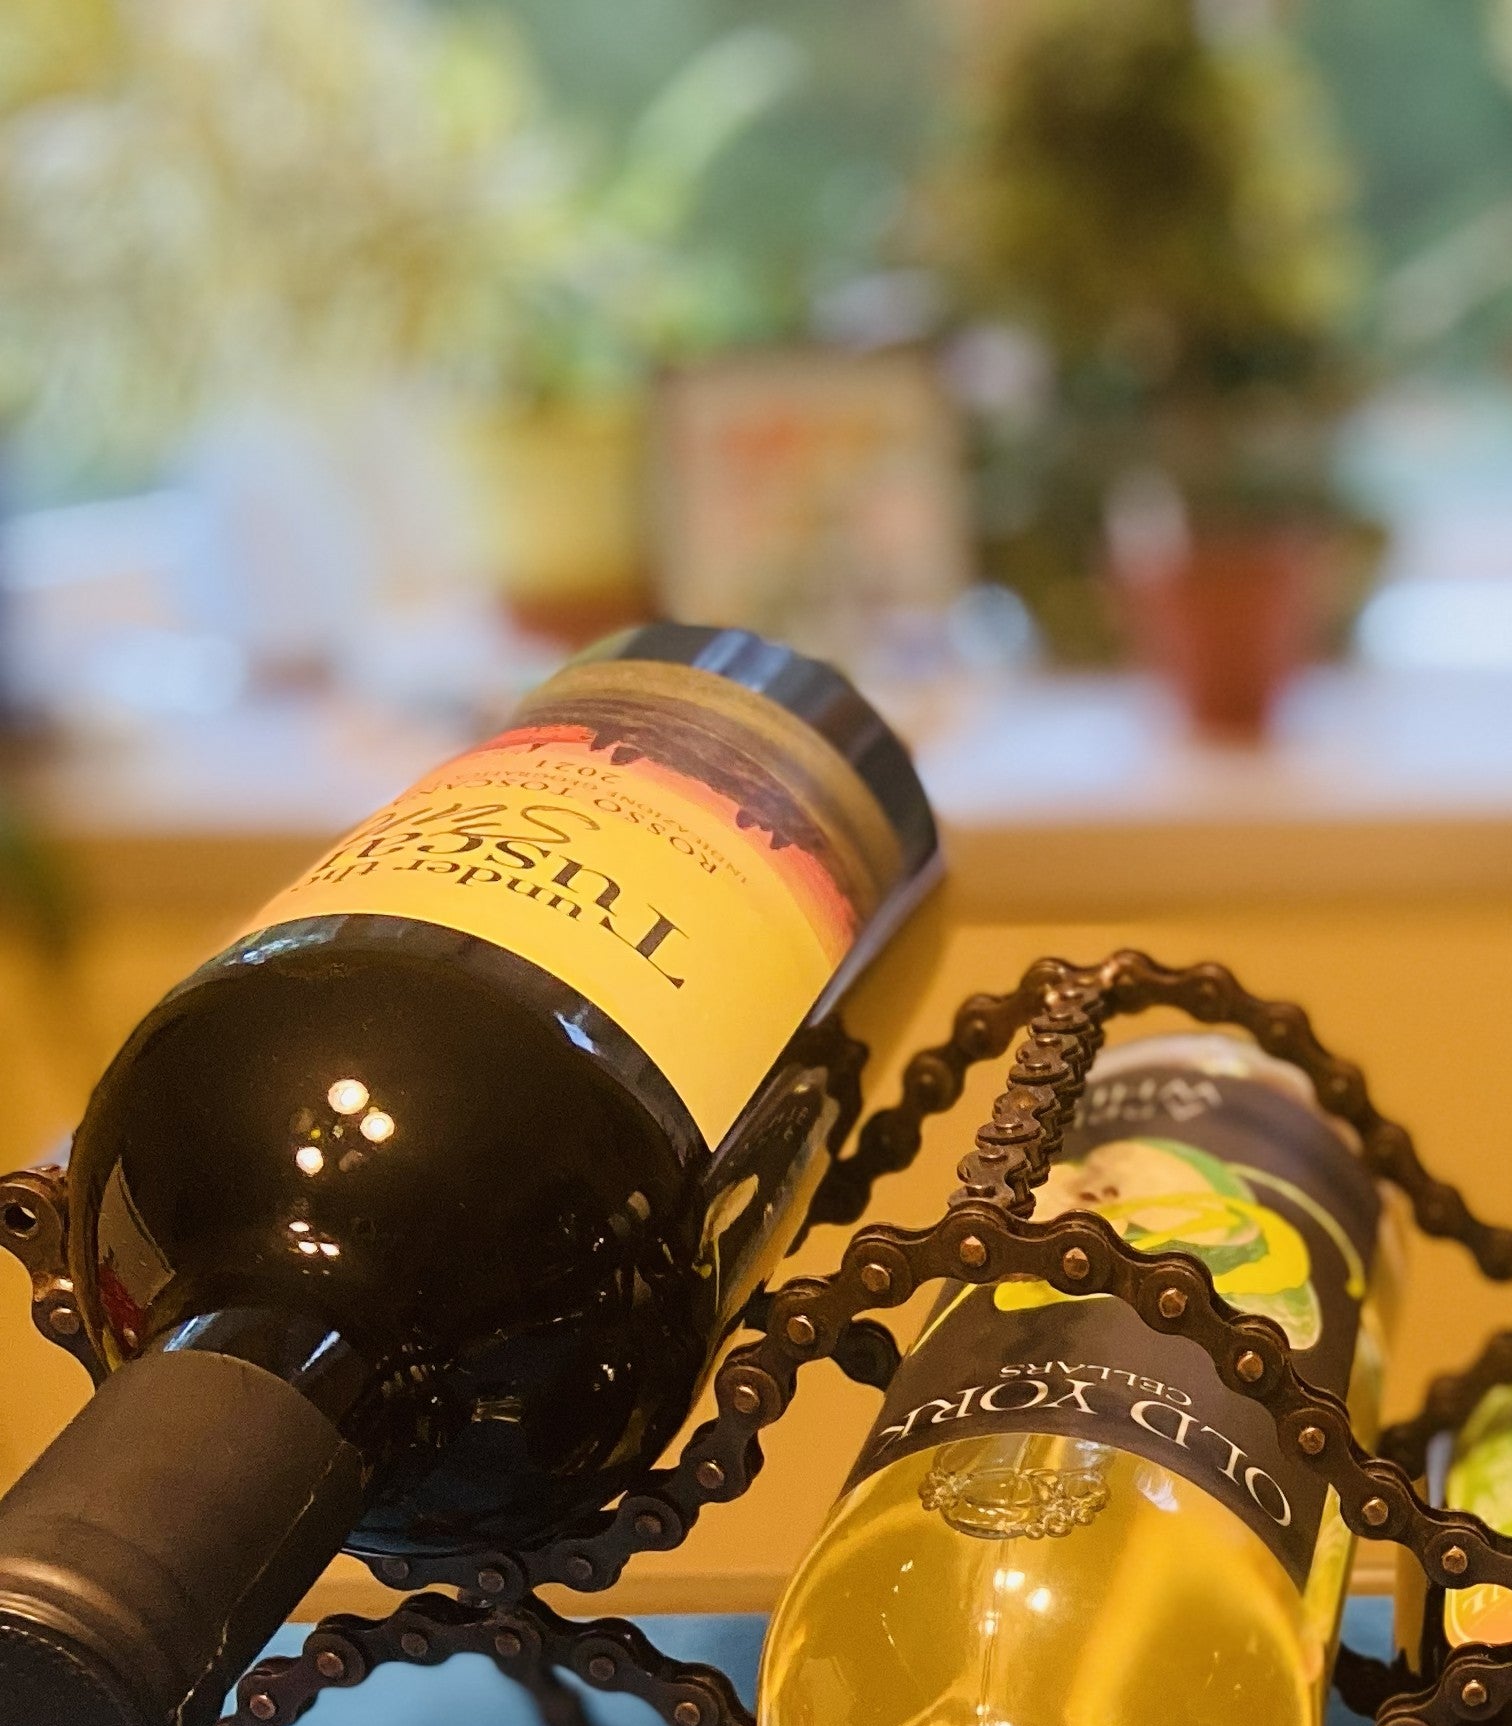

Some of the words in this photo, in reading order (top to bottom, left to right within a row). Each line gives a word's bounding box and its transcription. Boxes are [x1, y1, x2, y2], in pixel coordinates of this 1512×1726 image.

[537, 760, 622, 785] 2021
[594, 799, 717, 874] ROSSO
[393, 857, 580, 923] under
[999, 1361, 1193, 1406] CELLARS
[871, 1379, 1099, 1460] YORK
[1130, 1400, 1292, 1527] OLD
